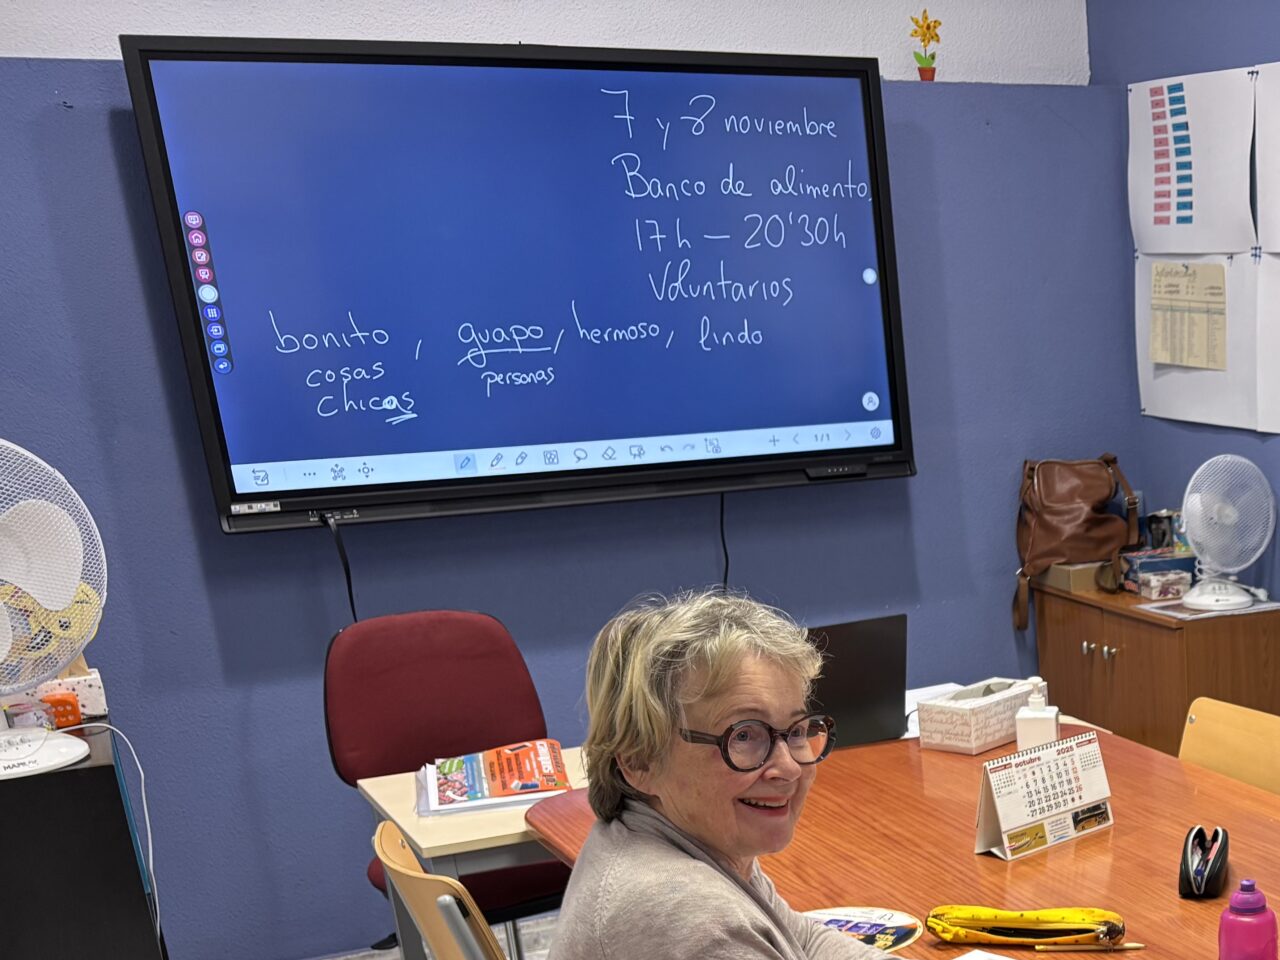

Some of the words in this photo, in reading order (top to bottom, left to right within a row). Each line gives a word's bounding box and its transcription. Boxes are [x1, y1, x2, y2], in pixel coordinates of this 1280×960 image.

[600, 88, 634, 139] 7
[656, 117, 670, 150] y
[724, 106, 838, 138] noviembre
[611, 152, 706, 201] Banco
[720, 162, 753, 196] de
[648, 258, 794, 307] Voluntarios
[698, 316, 764, 352] lindo
[306, 362, 386, 389] cosas
[480, 365, 556, 398] personas
[1014, 756, 1042, 769] octubre
[1056, 746, 1074, 756] 2025
